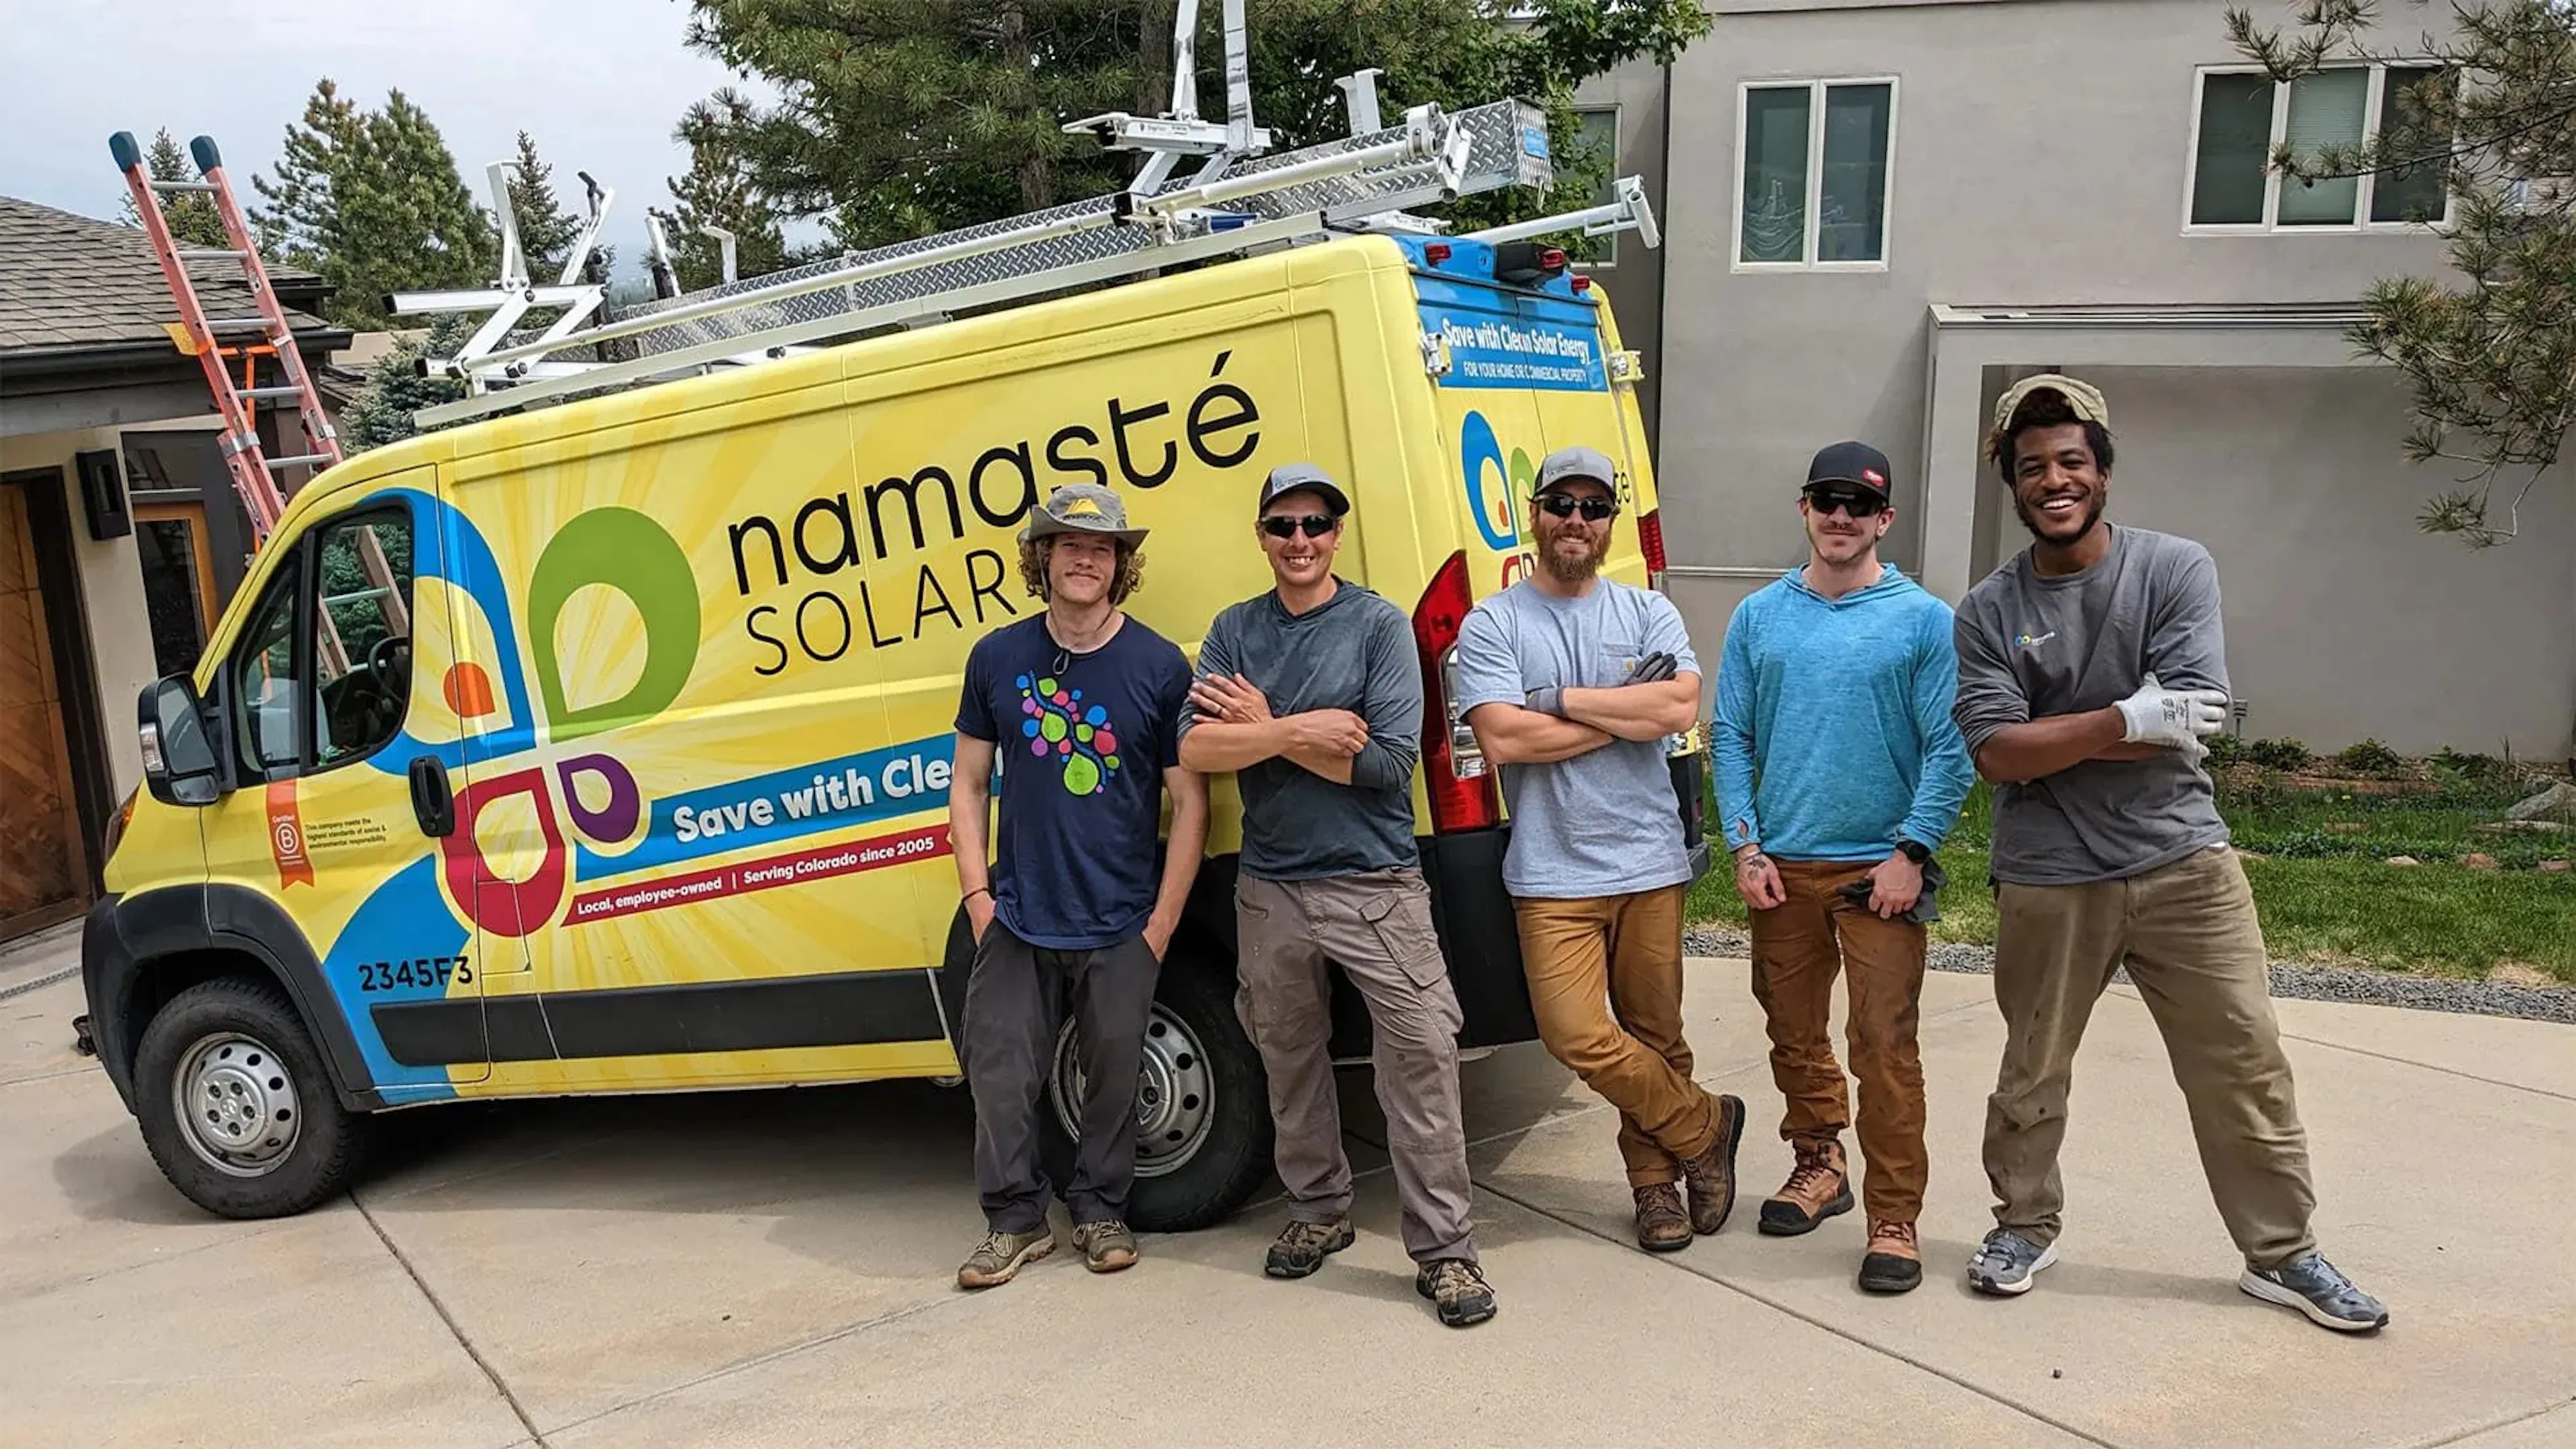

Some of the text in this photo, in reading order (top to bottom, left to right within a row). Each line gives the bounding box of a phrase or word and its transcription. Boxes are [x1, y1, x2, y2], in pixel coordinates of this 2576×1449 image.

[1443, 317, 1589, 365] Save with Clean Solar Energy
[1463, 361, 1479, 376] FOR
[1478, 362, 1497, 378] YOUR
[1496, 363, 1515, 379] HOME
[1515, 364, 1526, 380] OR
[727, 350, 1260, 595] namasté
[747, 549, 1018, 676] SOLAR
[674, 746, 1004, 843] Save with Cle
[280, 828, 294, 849] B
[578, 837, 935, 915] Local, employee-owned Serving Colorado since 2005
[358, 956, 473, 992] 2345F3
